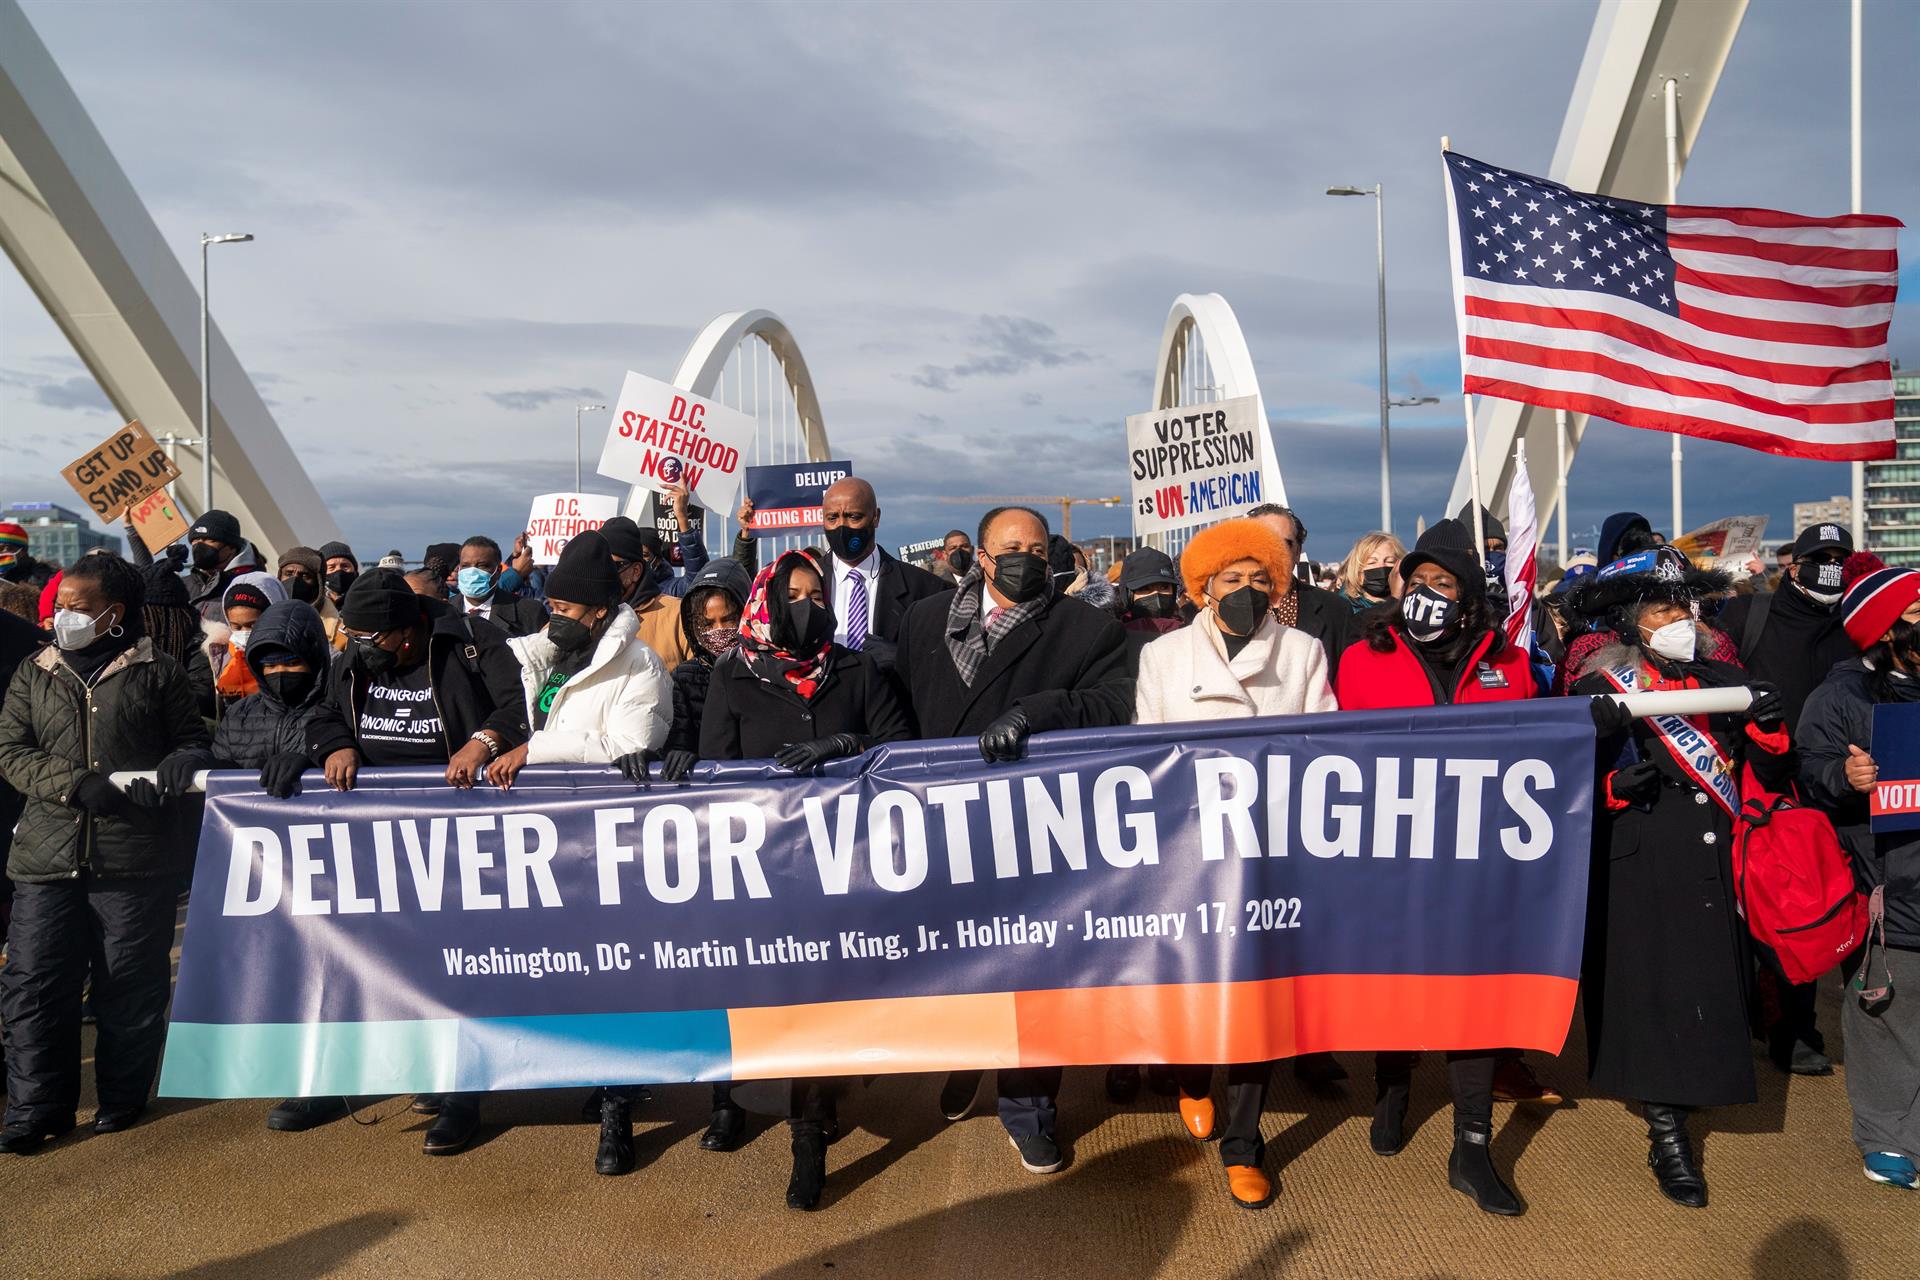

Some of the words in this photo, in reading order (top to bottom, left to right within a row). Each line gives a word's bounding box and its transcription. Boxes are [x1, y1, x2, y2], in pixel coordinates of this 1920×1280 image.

[668, 395, 706, 433] D.C.
[1154, 410, 1228, 444] VOTER
[75, 450, 111, 485] GET
[108, 432, 135, 461] UP
[618, 410, 739, 474] STATEHOOD
[1132, 430, 1254, 480] SUPPRESSION
[88, 468, 143, 514] STAND
[139, 449, 168, 478] UP
[555, 498, 581, 517] D.C.
[657, 517, 678, 530] GOOD
[754, 509, 799, 526] VOTING
[802, 508, 824, 523] RIG
[909, 537, 945, 553] STATEHOO
[408, 717, 443, 734] JUSTI
[1695, 753, 1718, 773] of
[1877, 784, 1920, 810] VOTI
[222, 813, 564, 917] DELIVER
[594, 801, 772, 906] FOR
[803, 766, 1160, 896] VOTING
[1194, 754, 1556, 861] RIGHTS
[443, 947, 590, 979] Washington,
[596, 942, 632, 971] DC
[653, 940, 738, 969] Martin
[745, 935, 831, 965] Luther
[839, 931, 909, 961] King,
[917, 924, 949, 953] Jr.
[956, 915, 1058, 950] Holiday
[1083, 910, 1187, 941] January
[1197, 902, 1236, 936] 17,
[1246, 897, 1302, 932] 2022
